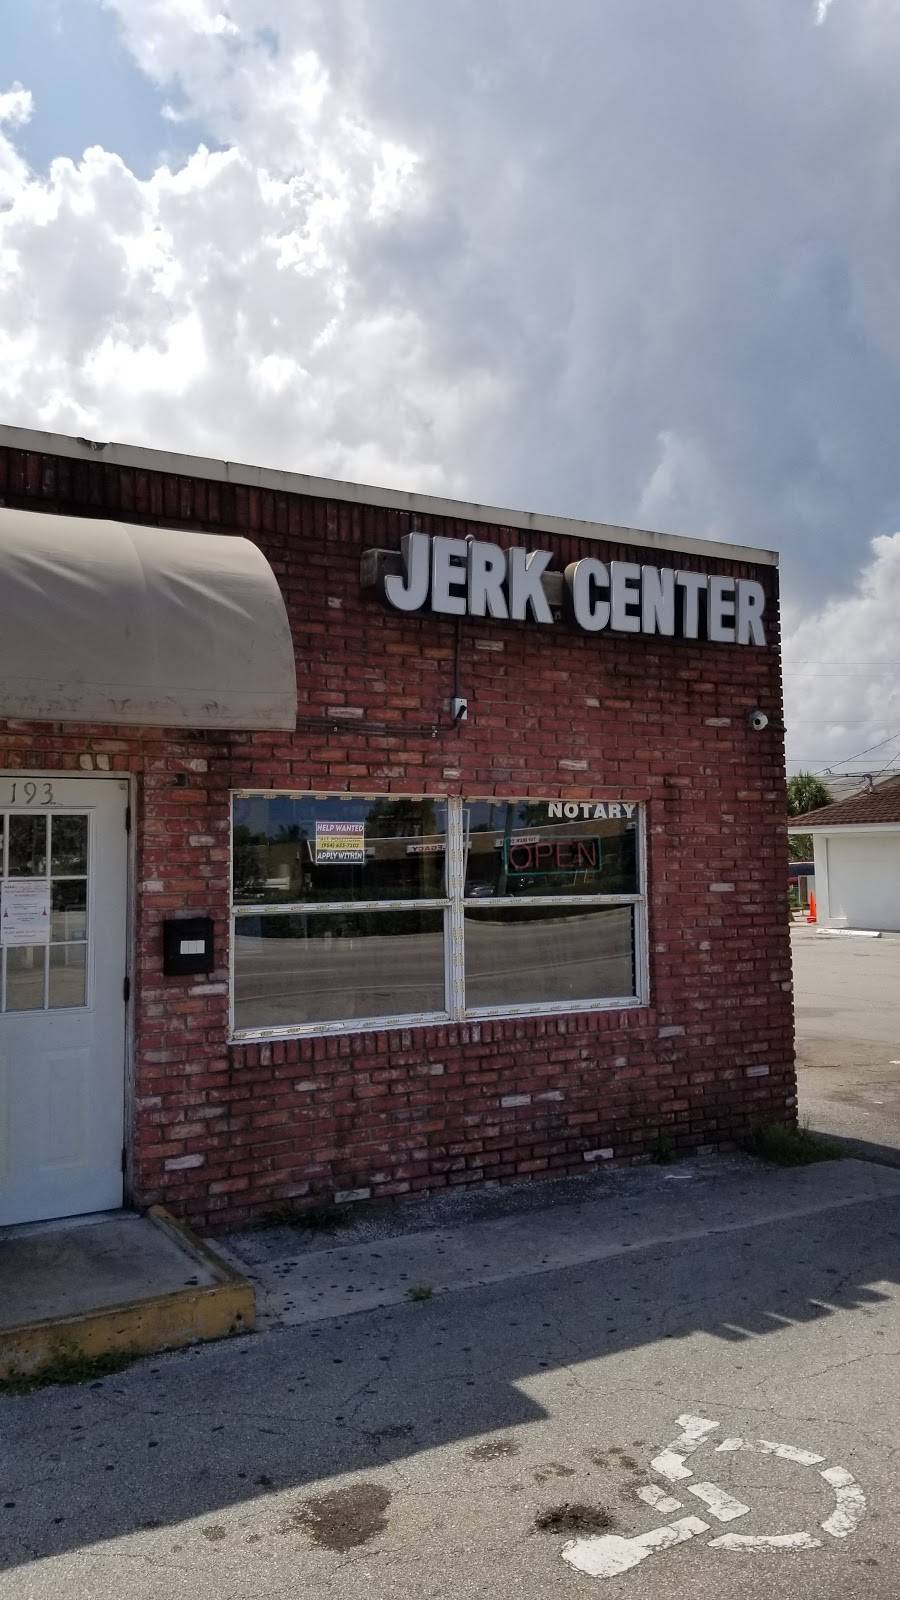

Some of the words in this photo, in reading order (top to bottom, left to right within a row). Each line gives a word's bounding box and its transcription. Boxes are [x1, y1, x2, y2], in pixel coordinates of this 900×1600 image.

[384, 531, 554, 625] JERK
[572, 557, 767, 646] CENTER
[11, 782, 53, 805] 193
[547, 802, 636, 819] NOTARY
[317, 823, 335, 832] HELP
[336, 824, 364, 832] WANTED
[317, 851, 338, 860] APPLY
[338, 851, 363, 860] WITHIN
[509, 839, 597, 871] OPEN
